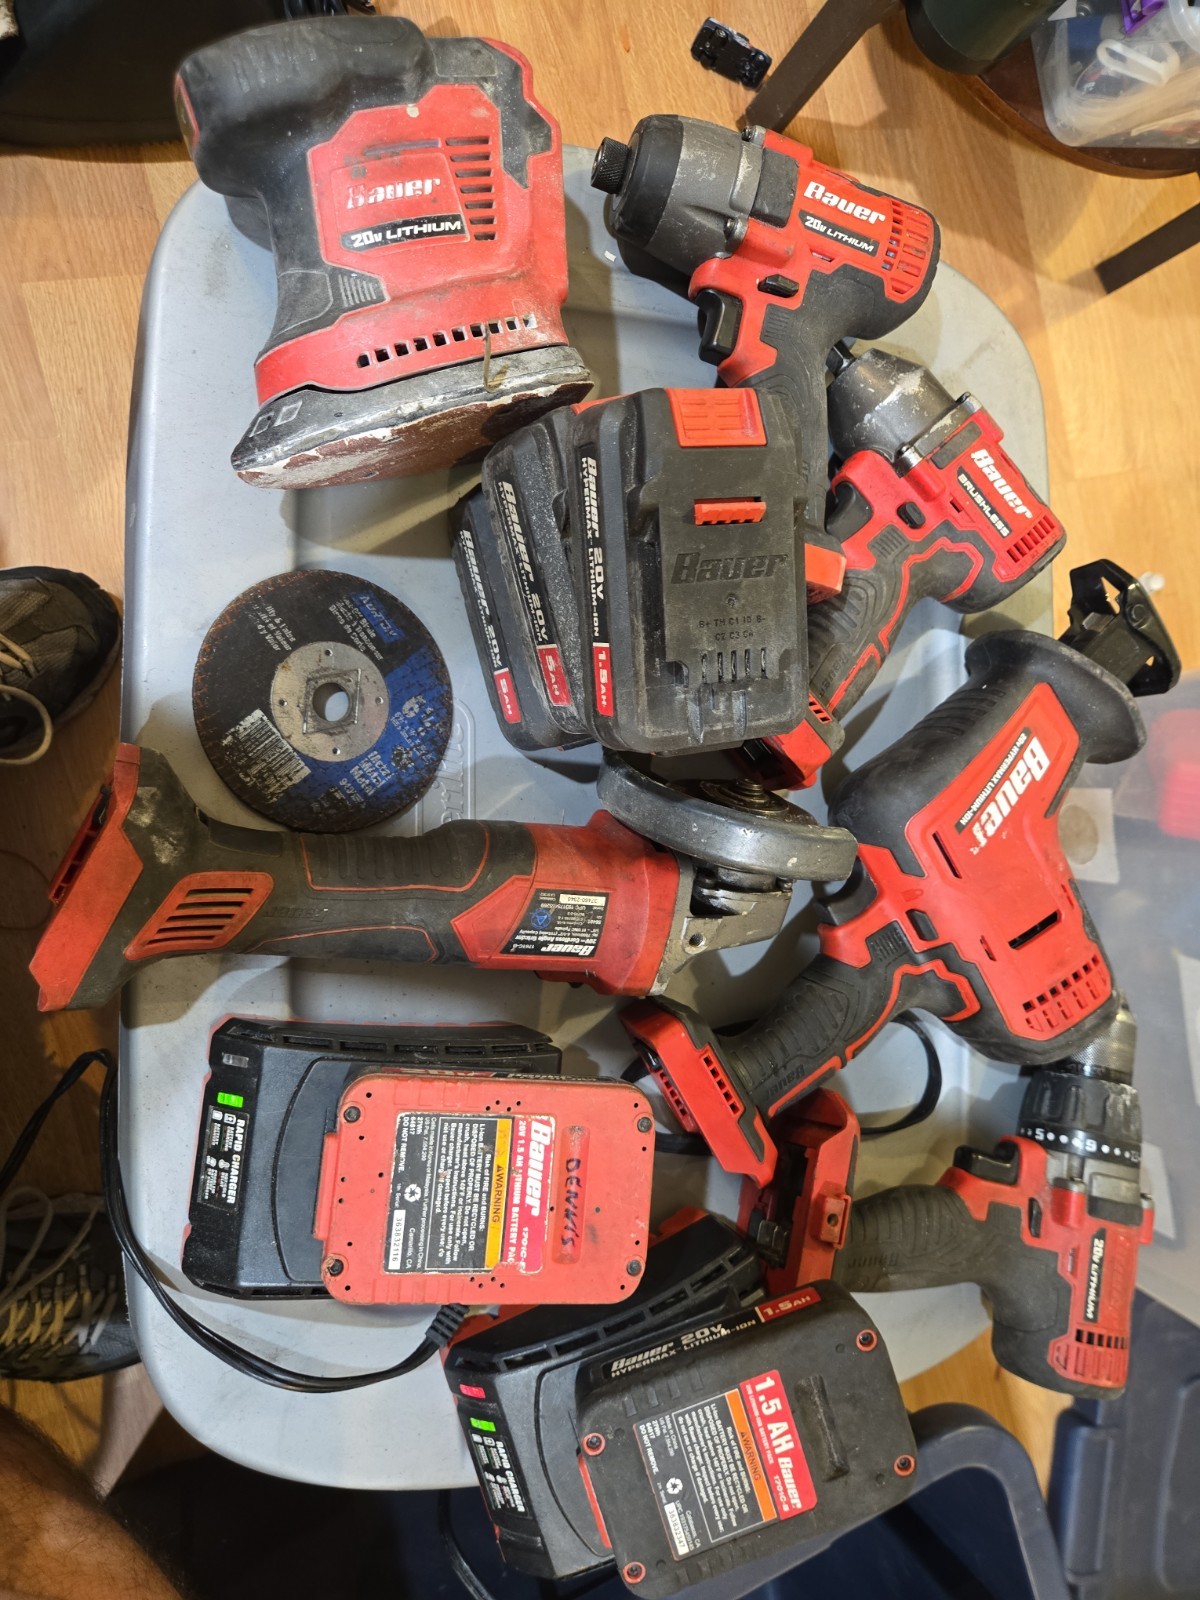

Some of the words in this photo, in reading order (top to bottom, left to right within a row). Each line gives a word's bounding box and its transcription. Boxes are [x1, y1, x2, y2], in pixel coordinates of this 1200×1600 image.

[347, 179, 440, 209] Bauer
[804, 181, 886, 224] Bauer
[386, 221, 461, 239] LITHIUM
[826, 228, 874, 252] LITHIUM
[587, 457, 600, 538] Bauer
[971, 449, 1033, 518] Bauer
[958, 473, 1010, 536] BRUSHLESS
[503, 481, 534, 582] Bauer
[582, 457, 592, 539] HYPERMAX
[588, 548, 600, 637] LITHIUM-ION
[462, 530, 490, 616] Bauer
[498, 482, 519, 555] HYPERMAX
[518, 562, 542, 642] LITHIUM-ION
[671, 552, 788, 584] Bauer
[990, 745, 1020, 783] HYPERMAX
[959, 781, 995, 826] LITHIUM-ION
[972, 737, 1051, 847] Bauer
[542, 944, 594, 955] Bauer
[233, 1118, 246, 1152] RAPID
[403, 1115, 409, 1126] DO
[414, 1117, 423, 1134] 27Wh
[517, 1120, 526, 1136] 20V
[470, 1124, 478, 1156] DISPOSED
[516, 1139, 525, 1152] 1.5
[1035, 1128, 1044, 1141] 5
[1086, 1138, 1097, 1152] 9
[470, 1158, 475, 1166] OF
[515, 1154, 523, 1166] AH
[526, 1121, 551, 1216] Bauer
[226, 1154, 241, 1204] CHARGER
[465, 1206, 470, 1214] Do
[473, 1193, 479, 1202] BE
[492, 1172, 503, 1222] WARNING
[561, 1158, 582, 1247] DENNIS
[418, 1218, 426, 1246] processing
[470, 1204, 478, 1239] RECYCLED
[508, 1206, 519, 1243] BATTERY
[391, 1216, 402, 1262] 363832116
[451, 1240, 460, 1261] Follow
[469, 1241, 474, 1251] OR
[406, 1259, 412, 1268] CA
[1086, 1264, 1099, 1319] LITHIUM
[611, 1349, 676, 1378] HYPERMAX
[683, 1320, 756, 1351] LITHIUM-ION
[611, 1341, 674, 1372] Bauer
[755, 1376, 783, 1416] 1.5
[640, 1425, 646, 1434] DO
[704, 1406, 717, 1435] DISPOSED
[714, 1434, 720, 1444] OF
[726, 1477, 731, 1485] Do
[716, 1420, 727, 1445] BATTERY
[767, 1421, 795, 1454] AH
[724, 1446, 733, 1462] MUST
[729, 1463, 736, 1472] BE
[743, 1440, 761, 1481] WARNING
[496, 1441, 510, 1468] RAPID
[505, 1470, 525, 1512] CHARGER
[732, 1473, 745, 1503] RECYCLED
[778, 1457, 802, 1510] Bauer
[674, 1500, 682, 1513] UPC
[742, 1503, 748, 1513] OR
[668, 1509, 684, 1548] 363832347
[695, 1539, 700, 1547] CA
